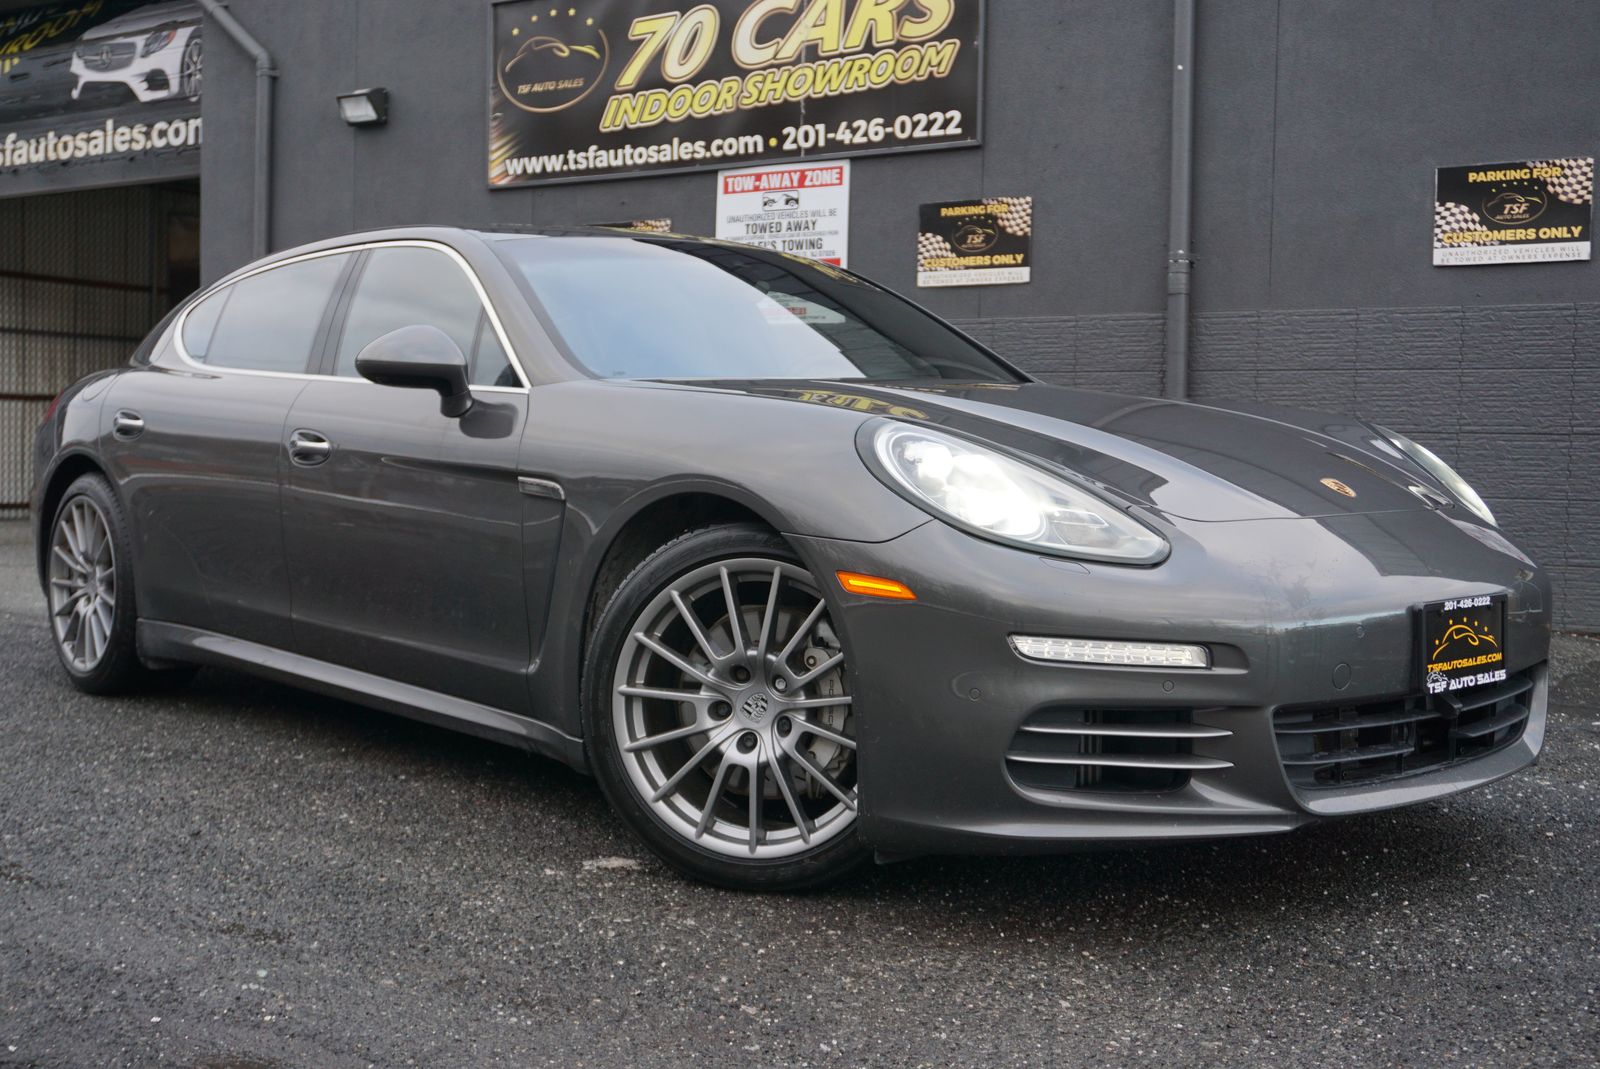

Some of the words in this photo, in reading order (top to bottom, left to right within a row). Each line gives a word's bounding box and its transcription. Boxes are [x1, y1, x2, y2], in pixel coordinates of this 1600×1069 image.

[615, 4, 720, 90] 70
[732, 0, 955, 68] CARS
[531, 81, 556, 92] AUTO
[558, 77, 584, 89] SALES
[600, 77, 740, 132] INDOOR
[741, 39, 960, 105] SHOWROOM
[505, 134, 764, 176] www.tsfautosales.com
[781, 110, 962, 150] 201-426-0222
[727, 171, 800, 192] TOW-AWAY
[804, 168, 840, 186] ZONE
[1468, 169, 1531, 183] PARKING
[1533, 167, 1562, 178] FOR
[810, 209, 826, 218] WILL
[828, 208, 837, 217] BE
[941, 204, 986, 217] PARKING
[987, 203, 1009, 214] FOR
[1503, 203, 1530, 215] TSF
[745, 221, 782, 235] TOWED
[786, 219, 818, 232] AWAY
[1443, 229, 1537, 244] CUSTOMERS
[1538, 226, 1582, 239] ONLY
[781, 238, 823, 252] TOWING
[924, 256, 991, 269] CUSTOMERS
[992, 253, 1024, 265] ONLY
[1444, 596, 1491, 611] 201-426-0222
[1427, 652, 1503, 673] TSFAUTOSALES.COM
[1427, 681, 1447, 694] TSF
[1448, 676, 1476, 691] AUTO
[1476, 669, 1507, 685] SALES
